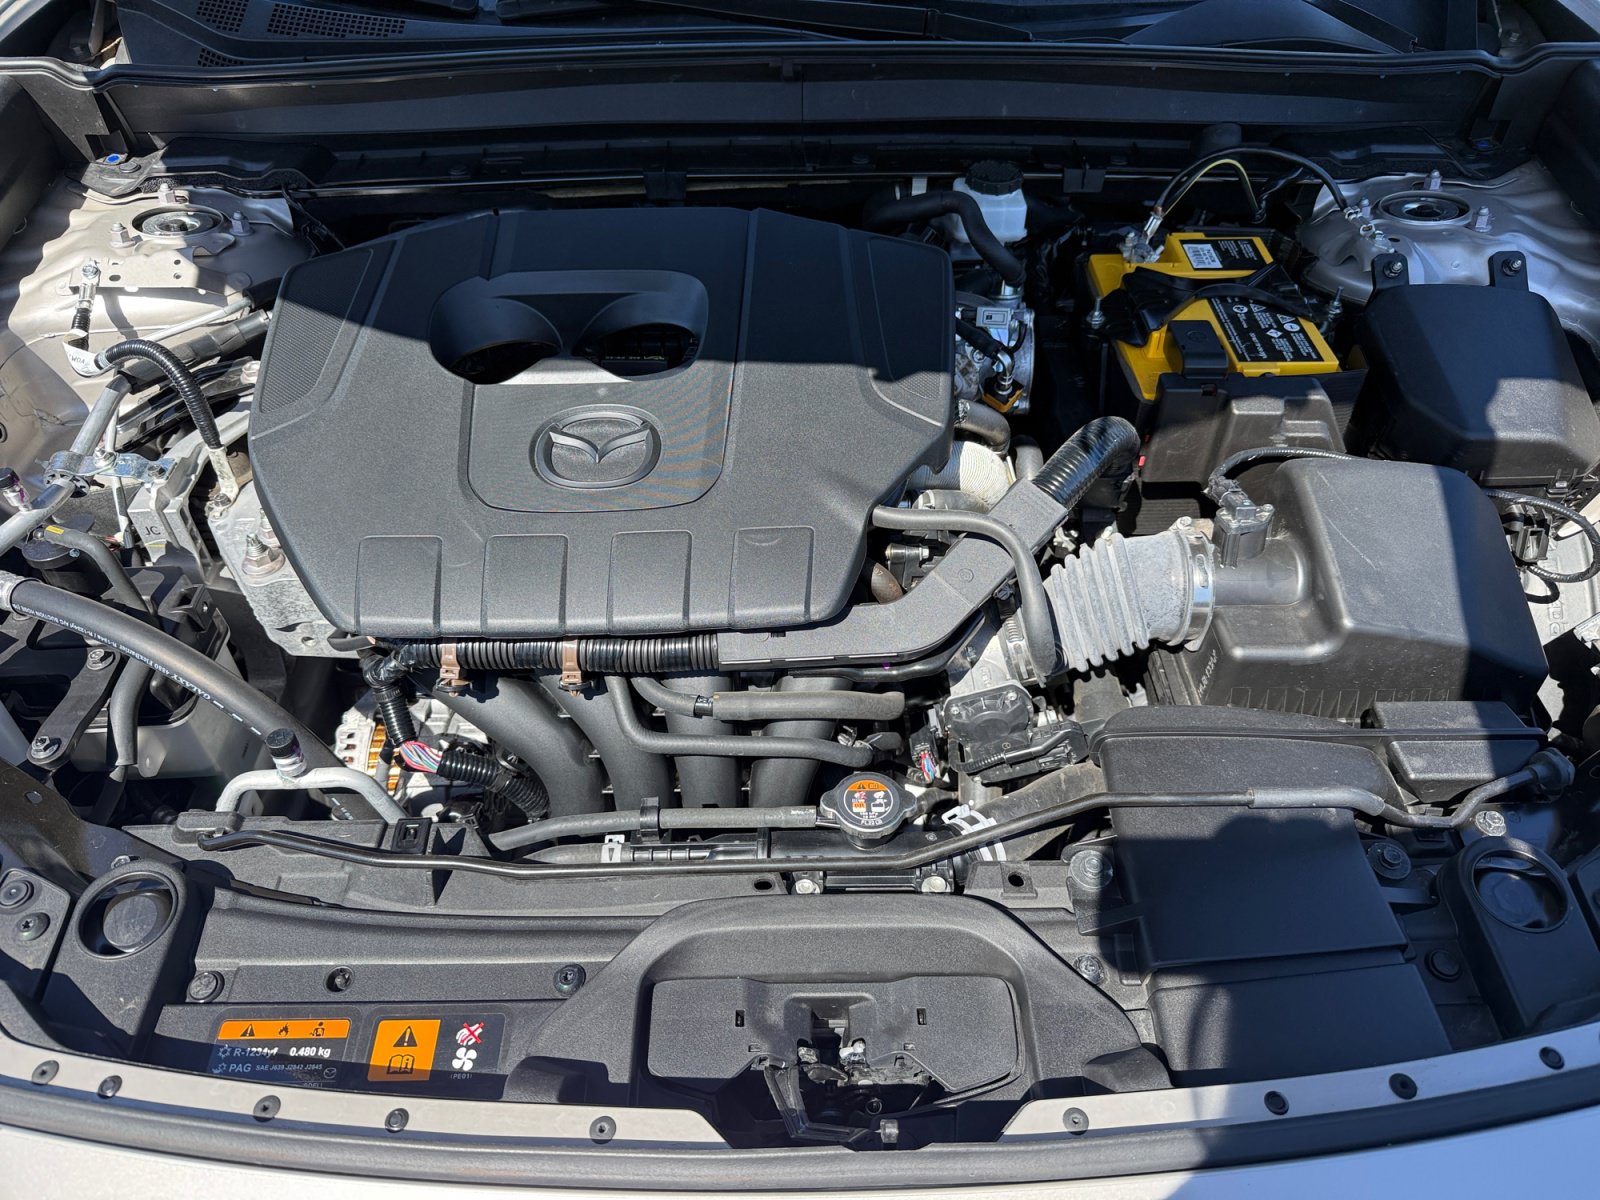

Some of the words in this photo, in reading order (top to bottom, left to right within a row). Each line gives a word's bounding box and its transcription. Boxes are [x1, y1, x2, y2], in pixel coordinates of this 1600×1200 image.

[171, 673, 211, 700] GALAXY
[233, 1047, 278, 1058] R-1234yf
[289, 1046, 317, 1057] 0.480
[318, 1046, 331, 1058] kg
[228, 1063, 251, 1073] PAG
[270, 1063, 285, 1071] J639
